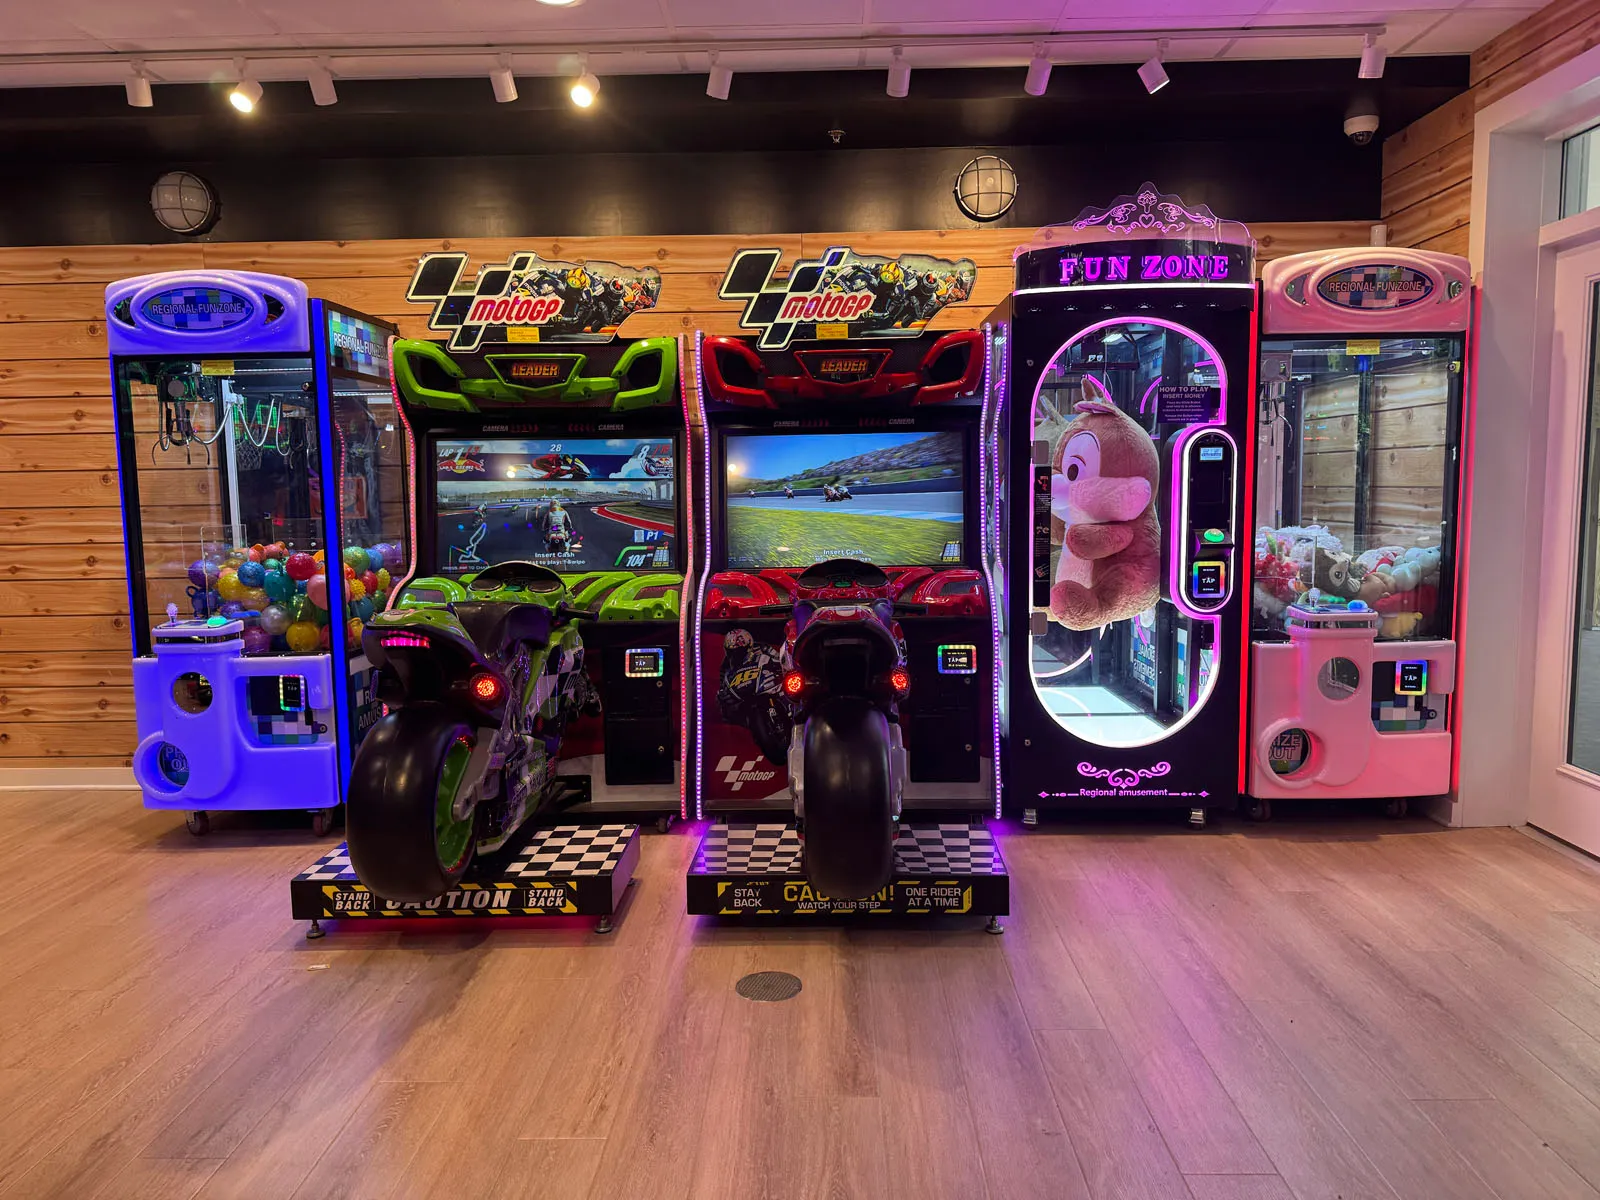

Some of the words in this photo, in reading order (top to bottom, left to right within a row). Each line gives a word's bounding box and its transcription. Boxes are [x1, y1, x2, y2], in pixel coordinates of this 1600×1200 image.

[1059, 256, 1131, 283] FUN
[1141, 255, 1229, 280] ZONE
[1329, 281, 1374, 292] REGIONAL
[1376, 281, 1395, 292] FUN
[1397, 280, 1422, 291] ZONE
[152, 304, 197, 314] REGIONAL
[199, 303, 216, 313] FUN
[218, 302, 243, 313] ZONE
[333, 331, 364, 353] REGIONAL
[511, 364, 559, 377] LEADER
[820, 359, 868, 373] LEADER
[438, 448, 453, 457] LAP
[550, 443, 562, 452] 28
[646, 531, 659, 541] P1
[626, 554, 646, 567] 104
[728, 670, 760, 688] 46
[1080, 788, 1116, 798] Regional
[1118, 788, 1168, 796] amusement
[528, 889, 564, 898] STAND
[734, 888, 761, 897] STAY
[905, 887, 927, 896] ONE
[930, 887, 961, 896] RIDER
[335, 893, 370, 901] STAND
[528, 897, 564, 907] BACK
[908, 897, 921, 906] AT
[923, 897, 931, 906] A
[935, 897, 959, 906] TIME
[335, 900, 371, 910] BACK
[734, 898, 762, 907] BACK
[797, 901, 831, 909] WATCH
[832, 901, 857, 909] YOUR
[858, 901, 881, 909] STEP
